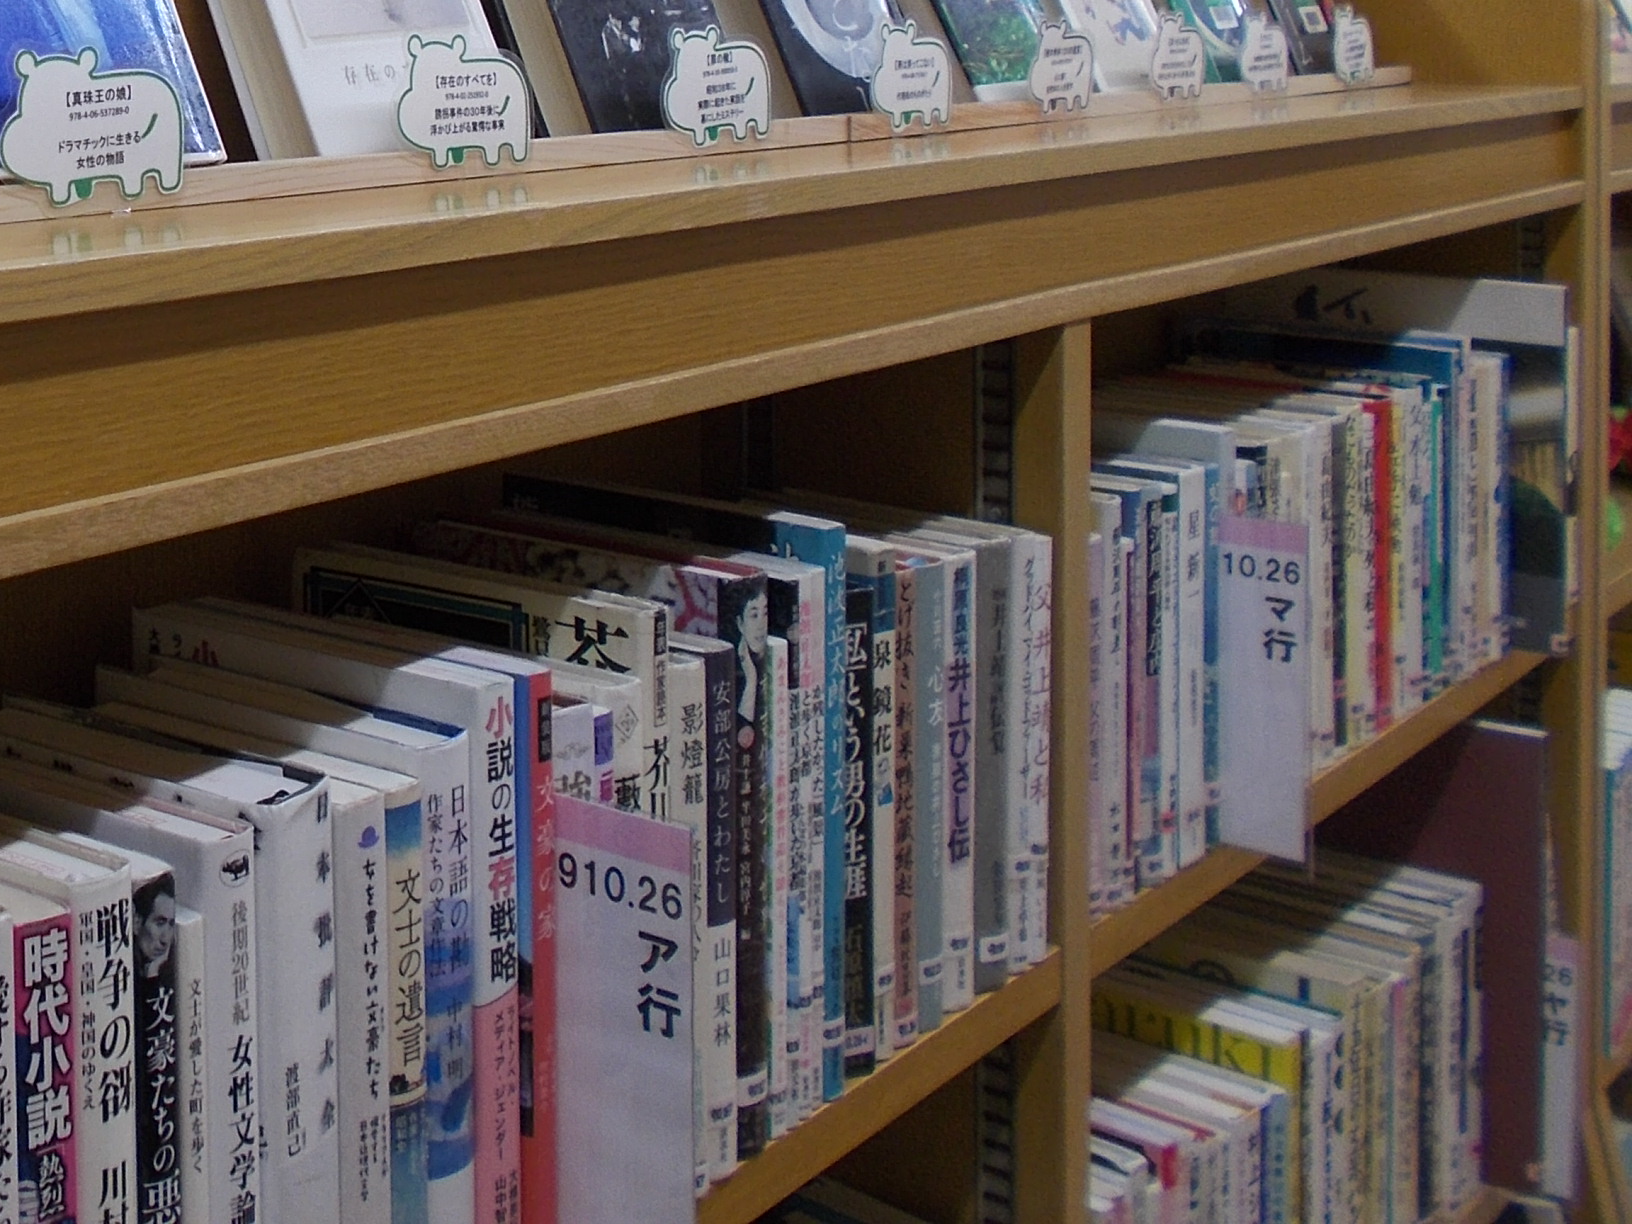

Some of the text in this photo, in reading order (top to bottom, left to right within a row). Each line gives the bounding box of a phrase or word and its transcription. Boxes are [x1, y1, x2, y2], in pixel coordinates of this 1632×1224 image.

[57, 130, 142, 154] ドラマチックに生きる
[65, 84, 132, 108] 【真珠王の娘】
[75, 149, 126, 170] 女性の物語
[1263, 595, 1299, 665] マ行
[483, 694, 517, 985] 小説の生存戦略
[712, 680, 732, 904] 安部公房とわたし
[946, 656, 972, 864] 井上ひさし伝
[392, 868, 424, 1068] 文士の遺言
[557, 852, 684, 921] 910.26
[636, 928, 683, 1040] ア行
[23, 927, 72, 1152] 時代小説
[78, 910, 97, 1112] 軍国・皇国・神国のゆくえ
[188, 977, 205, 1175] 文士が愛した町を歩く
[228, 899, 256, 1224] 後期20世紀 女性文学論
[713, 936, 732, 1047] 山口果林
[143, 986, 182, 1224] 文豪たちの悪
[284, 1061, 302, 1159] 渡部直己
